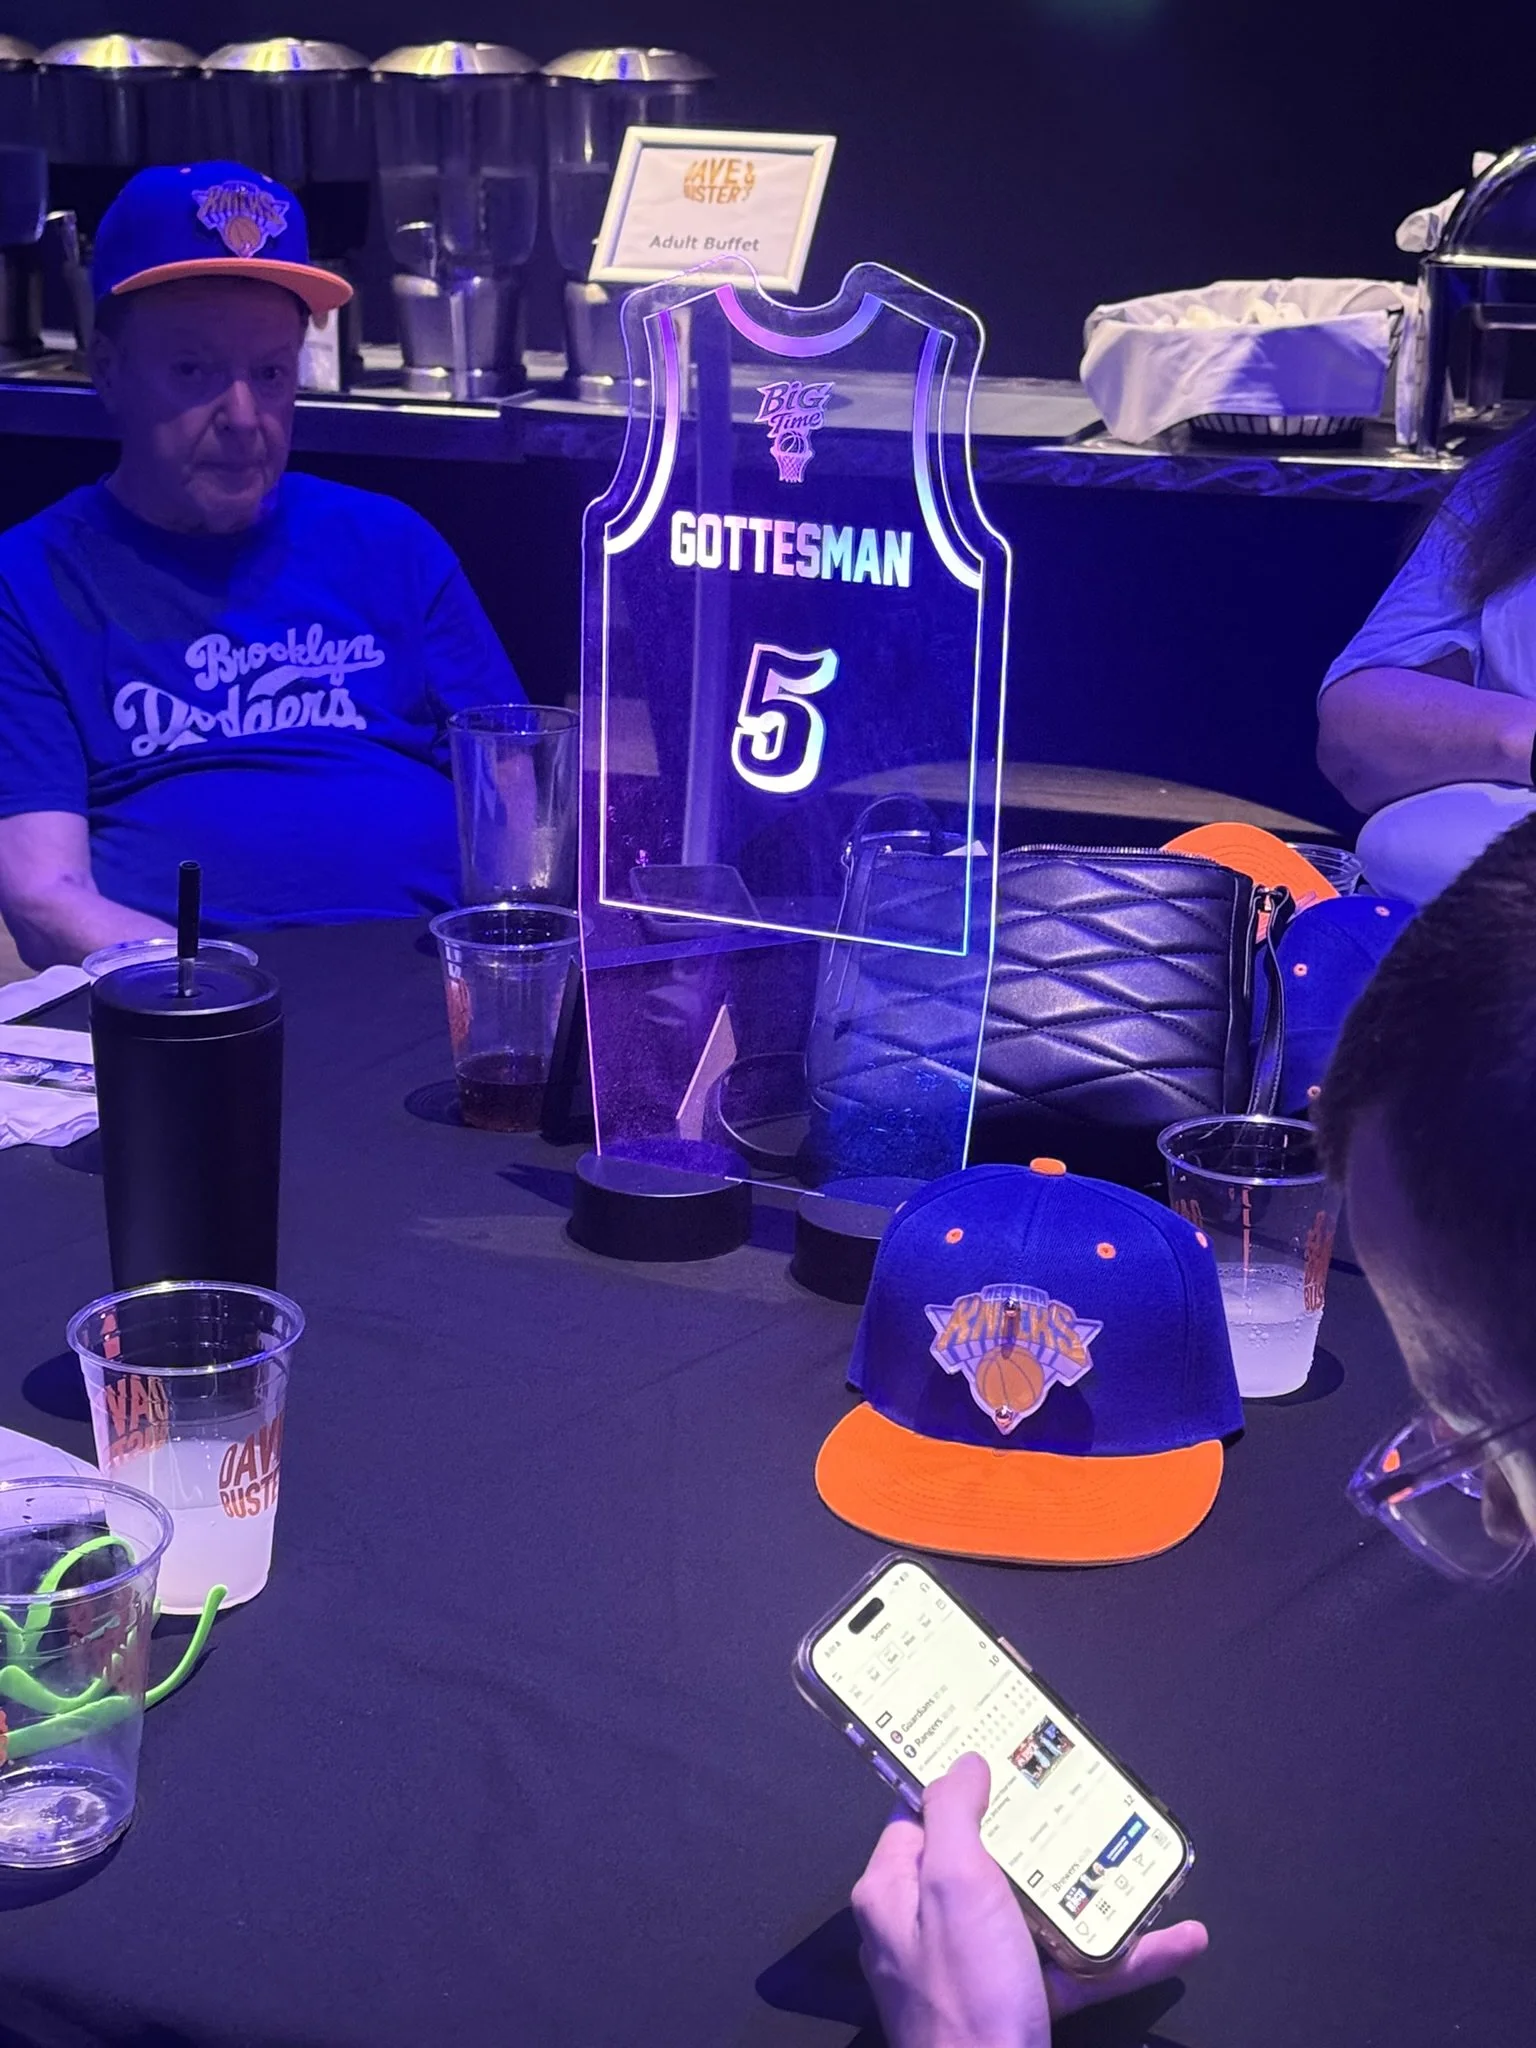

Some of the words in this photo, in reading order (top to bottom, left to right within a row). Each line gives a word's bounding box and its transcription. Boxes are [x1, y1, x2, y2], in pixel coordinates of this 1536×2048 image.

[650, 235, 698, 250] Adult
[704, 236, 760, 252] Buffet
[770, 410, 823, 436] Time
[670, 509, 914, 588] GOTTESMAN
[185, 623, 385, 692] Brooklyn
[731, 643, 840, 793] 5
[936, 1294, 1087, 1366] KNICKS
[870, 1619, 892, 1642] Scores
[900, 1695, 935, 1733] Guardians
[913, 1715, 944, 1747] Rangers
[987, 1654, 1000, 1666] 10
[1051, 1860, 1081, 1892] Brewers
[1122, 1793, 1135, 1807] 12
